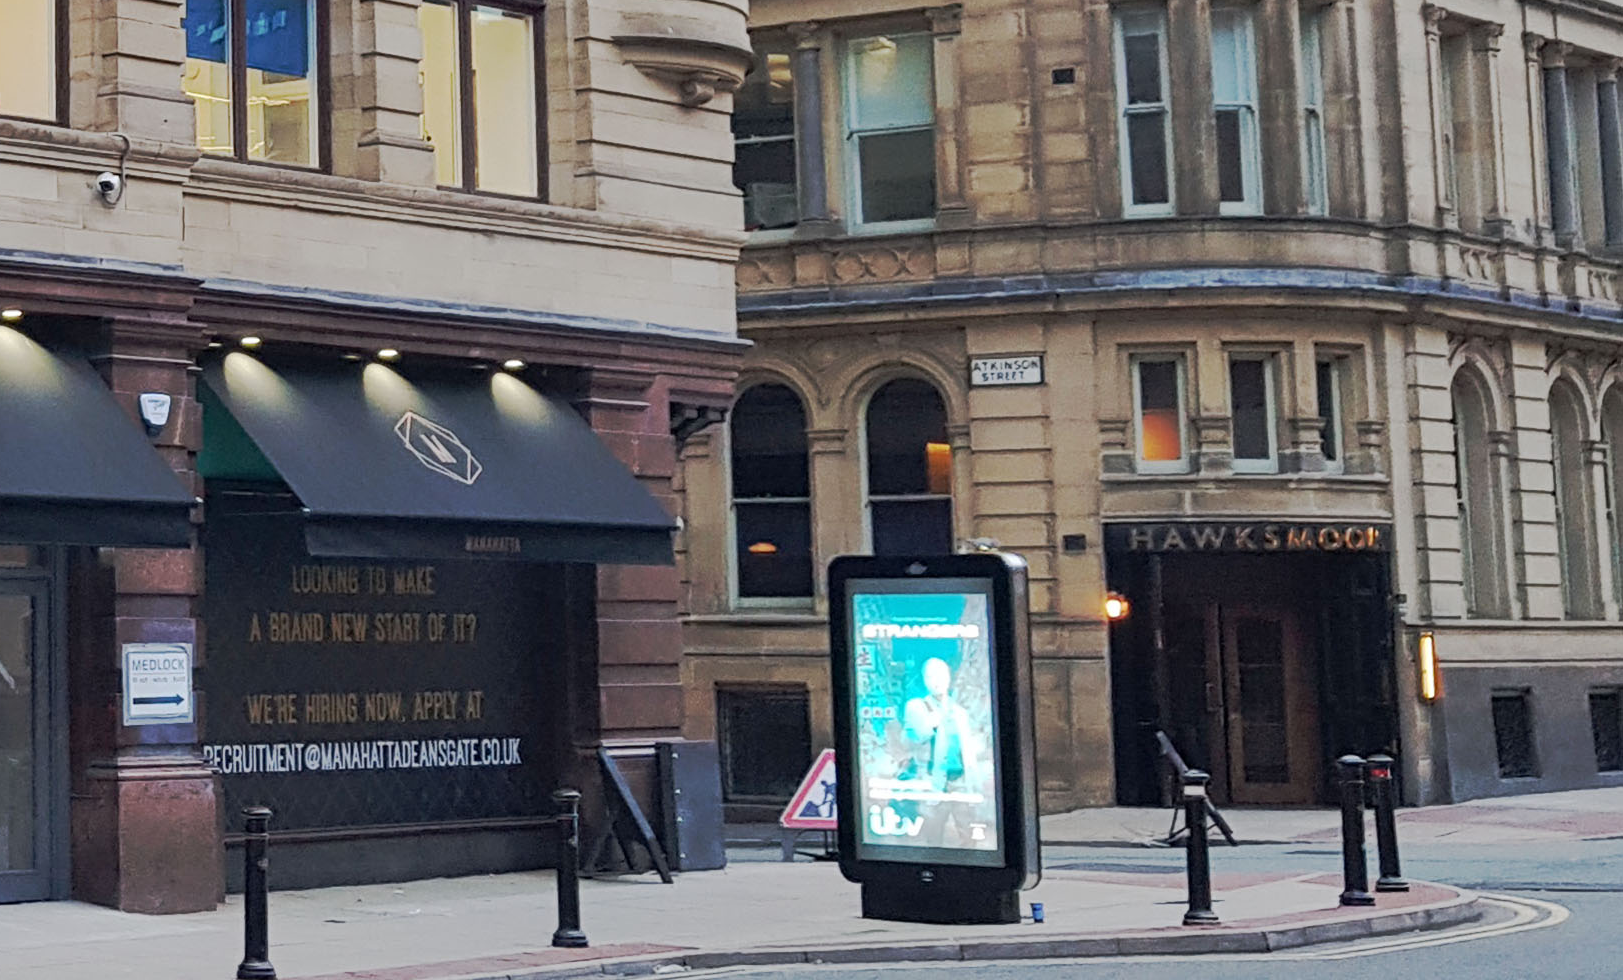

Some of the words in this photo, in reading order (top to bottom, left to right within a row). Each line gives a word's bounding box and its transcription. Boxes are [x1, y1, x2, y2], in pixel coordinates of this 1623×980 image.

[973, 359, 1039, 372] ATKINSON
[981, 370, 1024, 381] STREET
[291, 565, 359, 595] LOOKING
[369, 566, 387, 595] TO
[394, 566, 435, 595] MAKE
[250, 613, 261, 643] A
[270, 613, 324, 643] BRAND
[330, 613, 367, 643] NEW
[376, 613, 421, 643] START
[429, 614, 447, 642] OF
[453, 614, 477, 642] IT?
[132, 658, 185, 671] MEDLOCK
[247, 694, 297, 724] WE'RE
[306, 693, 357, 723] HIRING
[365, 692, 406, 722] NOW,
[413, 691, 458, 721] APPLY
[466, 691, 484, 719] AT
[203, 738, 522, 773] RECRUITMENT@MANAHATTADEANSGATE.CO.UK
[869, 804, 924, 836] itv
